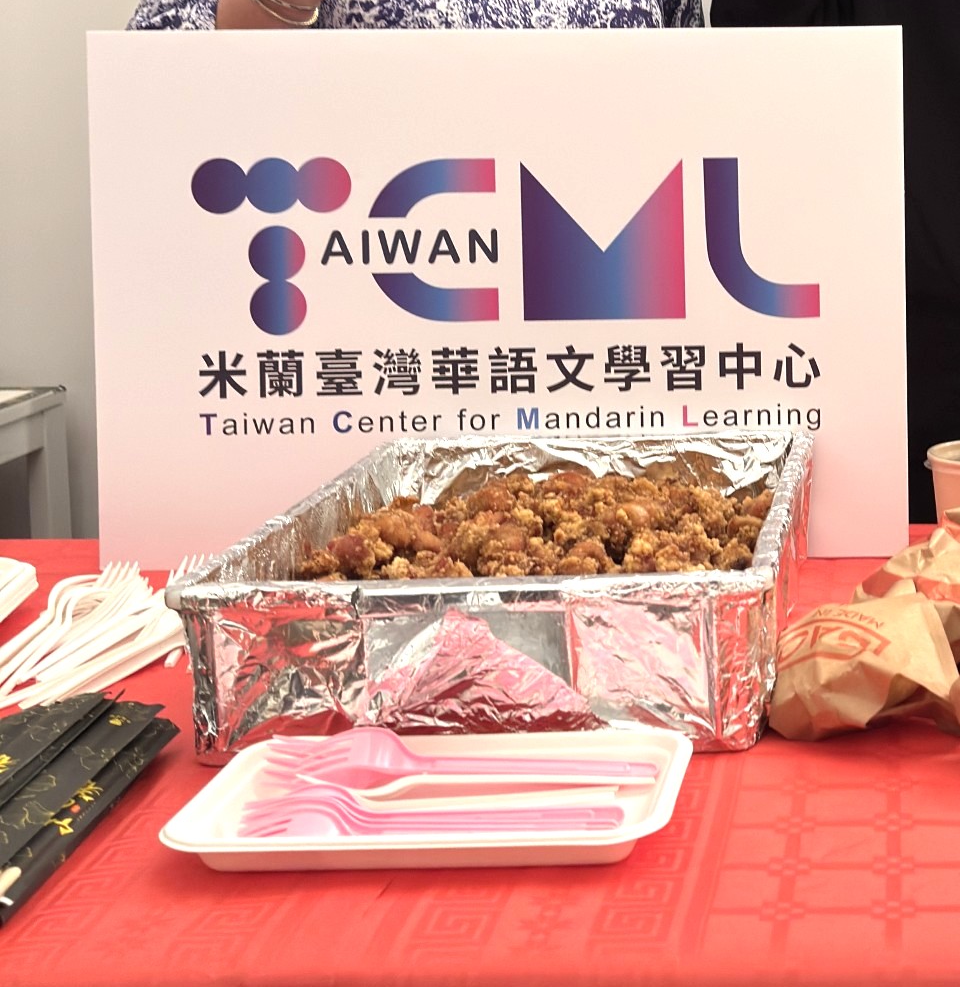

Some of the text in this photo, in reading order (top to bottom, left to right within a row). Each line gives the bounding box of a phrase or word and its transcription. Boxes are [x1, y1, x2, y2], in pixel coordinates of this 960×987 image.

[198, 342, 822, 399] 米蘭臺灣華語文學習中心
[199, 402, 822, 436] Taiwan Center for Mandarin Learning
